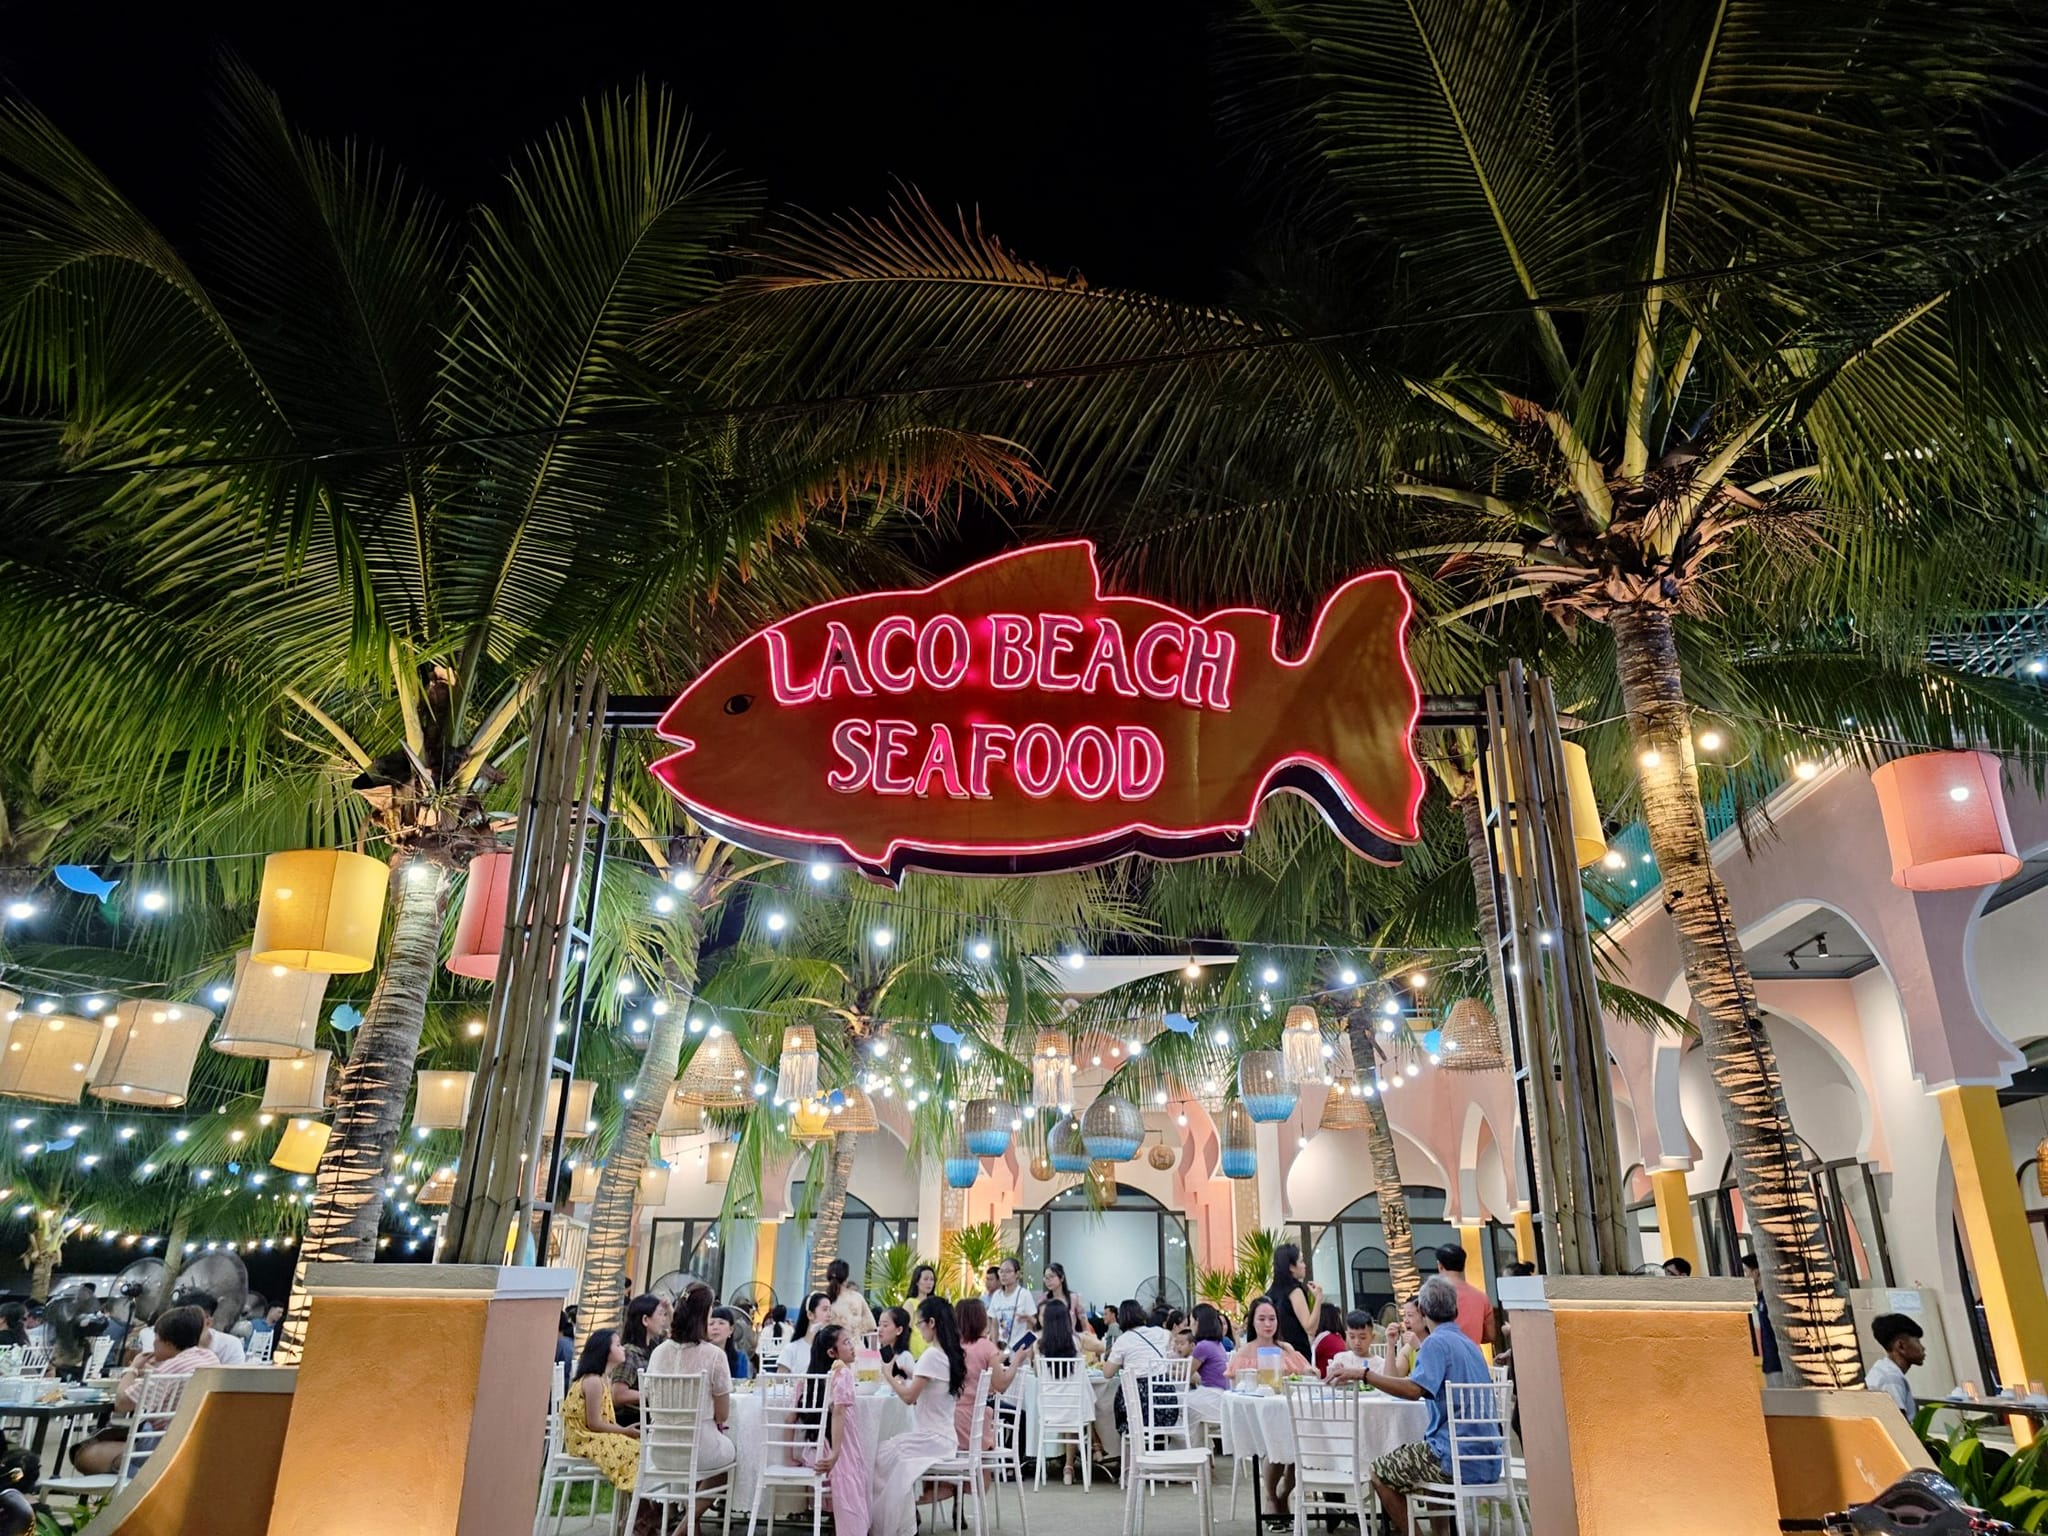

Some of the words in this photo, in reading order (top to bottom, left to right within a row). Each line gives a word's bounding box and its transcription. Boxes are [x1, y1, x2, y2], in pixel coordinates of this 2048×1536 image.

[763, 614, 971, 704] LACO
[987, 614, 1235, 710] BEACH
[828, 718, 1164, 799] SEAFOOD
